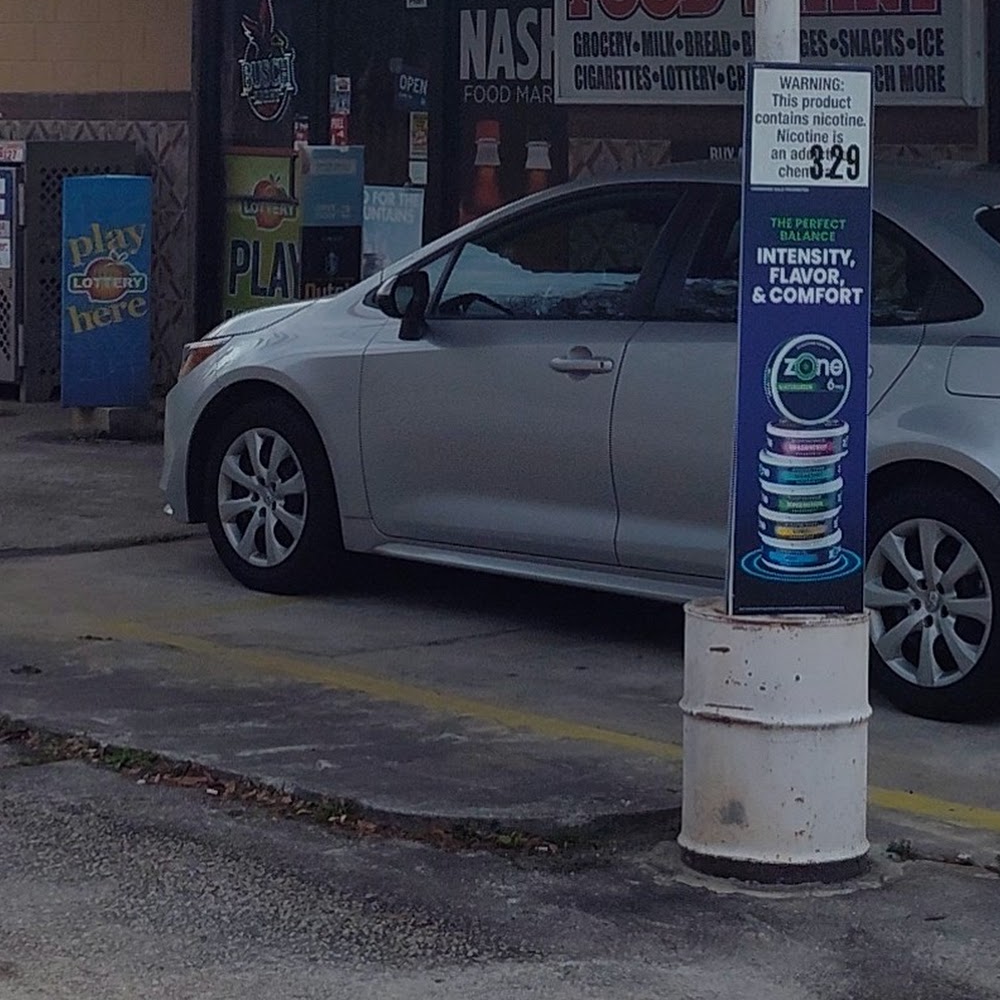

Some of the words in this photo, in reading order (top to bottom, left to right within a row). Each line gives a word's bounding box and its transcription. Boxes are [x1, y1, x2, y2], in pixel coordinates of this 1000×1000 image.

[573, 31, 633, 57] GROCERY
[641, 31, 677, 57] MILK
[684, 31, 730, 57] BREAD
[838, 28, 906, 57] SNACKS
[915, 28, 945, 57] ICE
[399, 73, 428, 96] OPEN
[574, 65, 652, 92] CIGARETTES
[659, 65, 717, 92] LOTTERY
[900, 65, 946, 92] MORE
[779, 76, 845, 91] WARNING:
[463, 85, 510, 103] FOOD
[516, 85, 553, 103] MAR
[772, 93, 799, 108] This
[802, 95, 852, 110] product
[755, 111, 809, 126] contains
[813, 113, 866, 127] nicotine.
[776, 129, 829, 144] Nicotine
[832, 130, 844, 144] is
[771, 148, 787, 161] an
[243, 200, 296, 216] LOTTERY
[373, 192, 396, 207] FOR
[364, 206, 415, 223] UNTAINS
[770, 217, 794, 229] THE
[795, 217, 847, 230] PERFECT
[68, 222, 146, 267] play
[780, 231, 836, 243] BALANCE
[756, 247, 856, 268] INTENSITY,
[73, 277, 143, 289] LOTTERY
[769, 267, 845, 287] FLAVOR,
[751, 286, 767, 305] &
[769, 287, 864, 306] COMFORT
[67, 297, 147, 334] here
